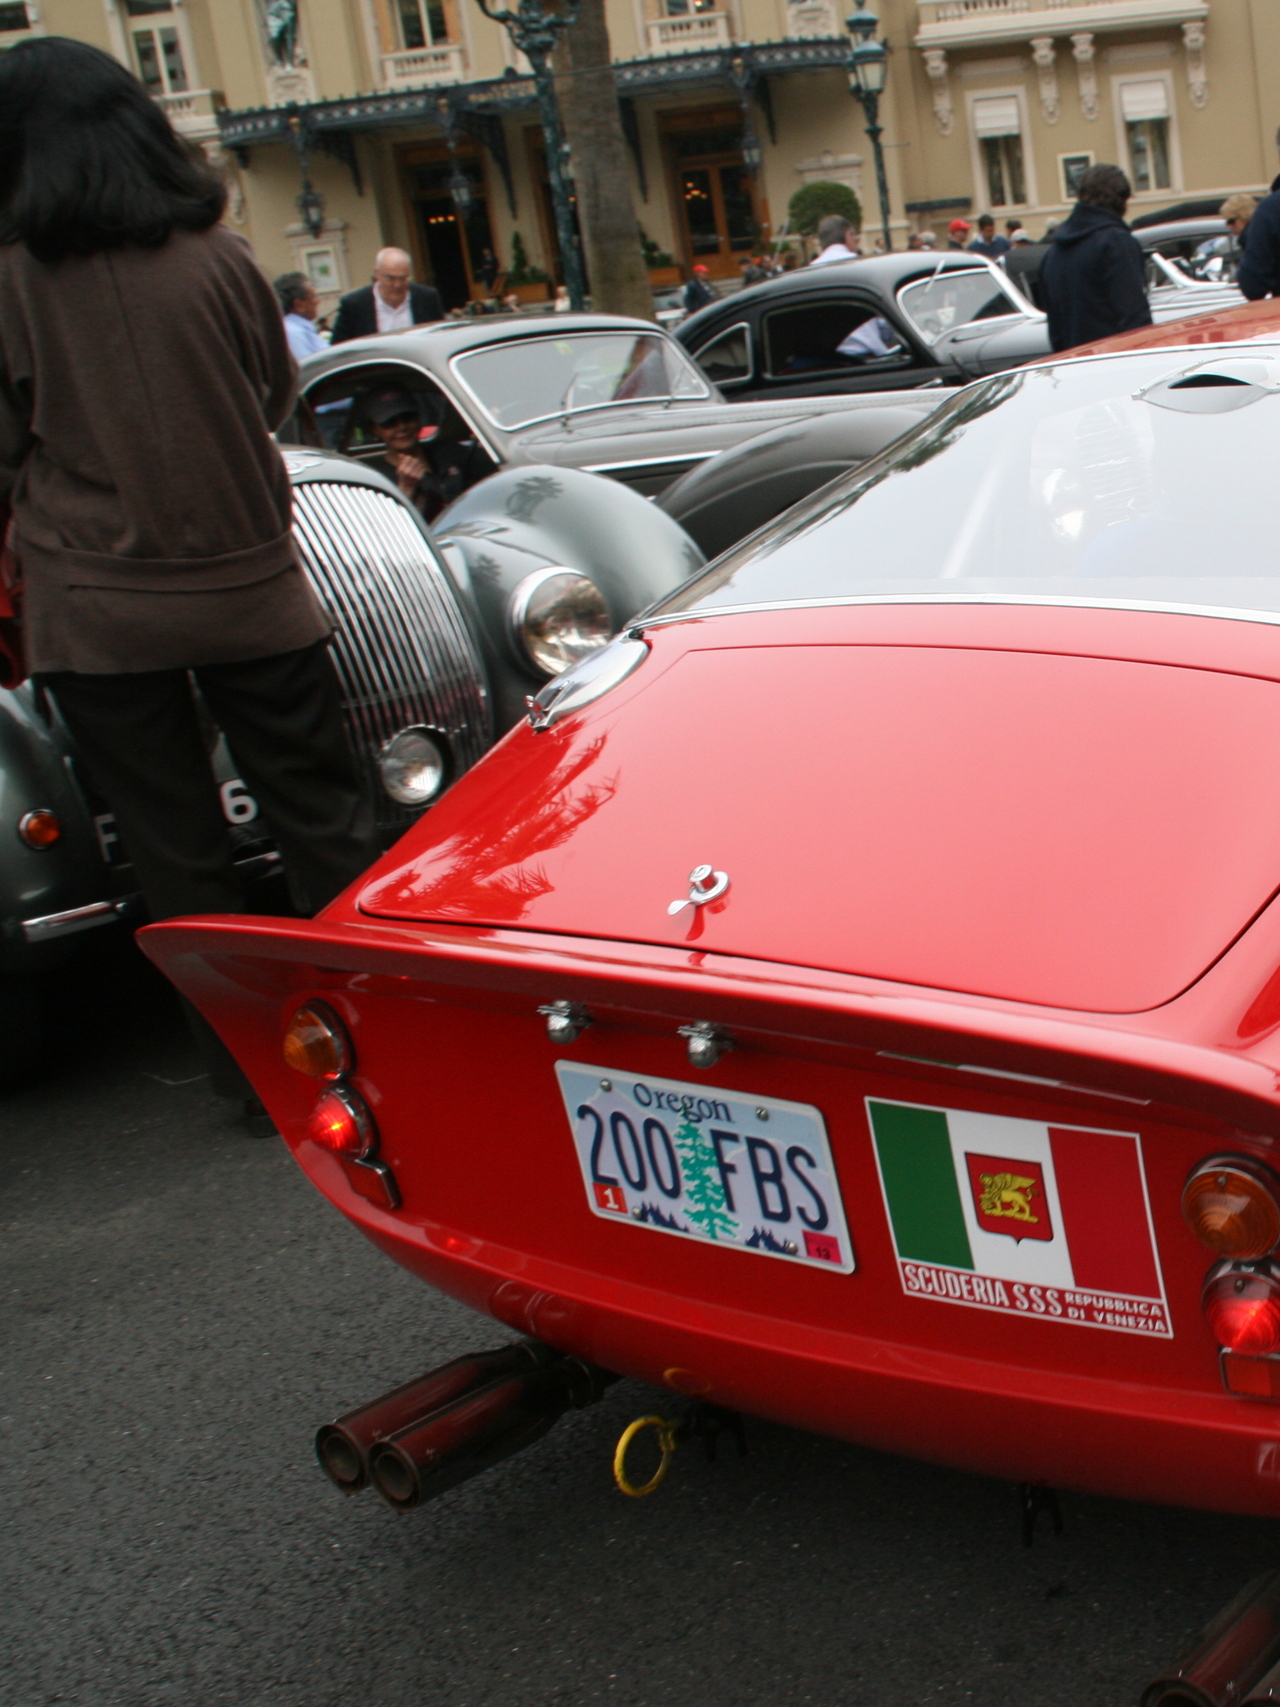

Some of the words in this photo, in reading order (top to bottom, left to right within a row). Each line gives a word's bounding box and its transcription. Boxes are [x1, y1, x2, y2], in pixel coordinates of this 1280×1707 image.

[633, 1082, 736, 1124] Oregon
[577, 1104, 682, 1200] 200
[710, 1128, 829, 1232] FBS
[602, 1188, 620, 1210] 1
[903, 1263, 1011, 1308] SCUDERIA
[1064, 1291, 1162, 1318] REPUBBLICA
[1066, 1307, 1086, 1321] DI
[1092, 1310, 1167, 1333] VENEZIA
